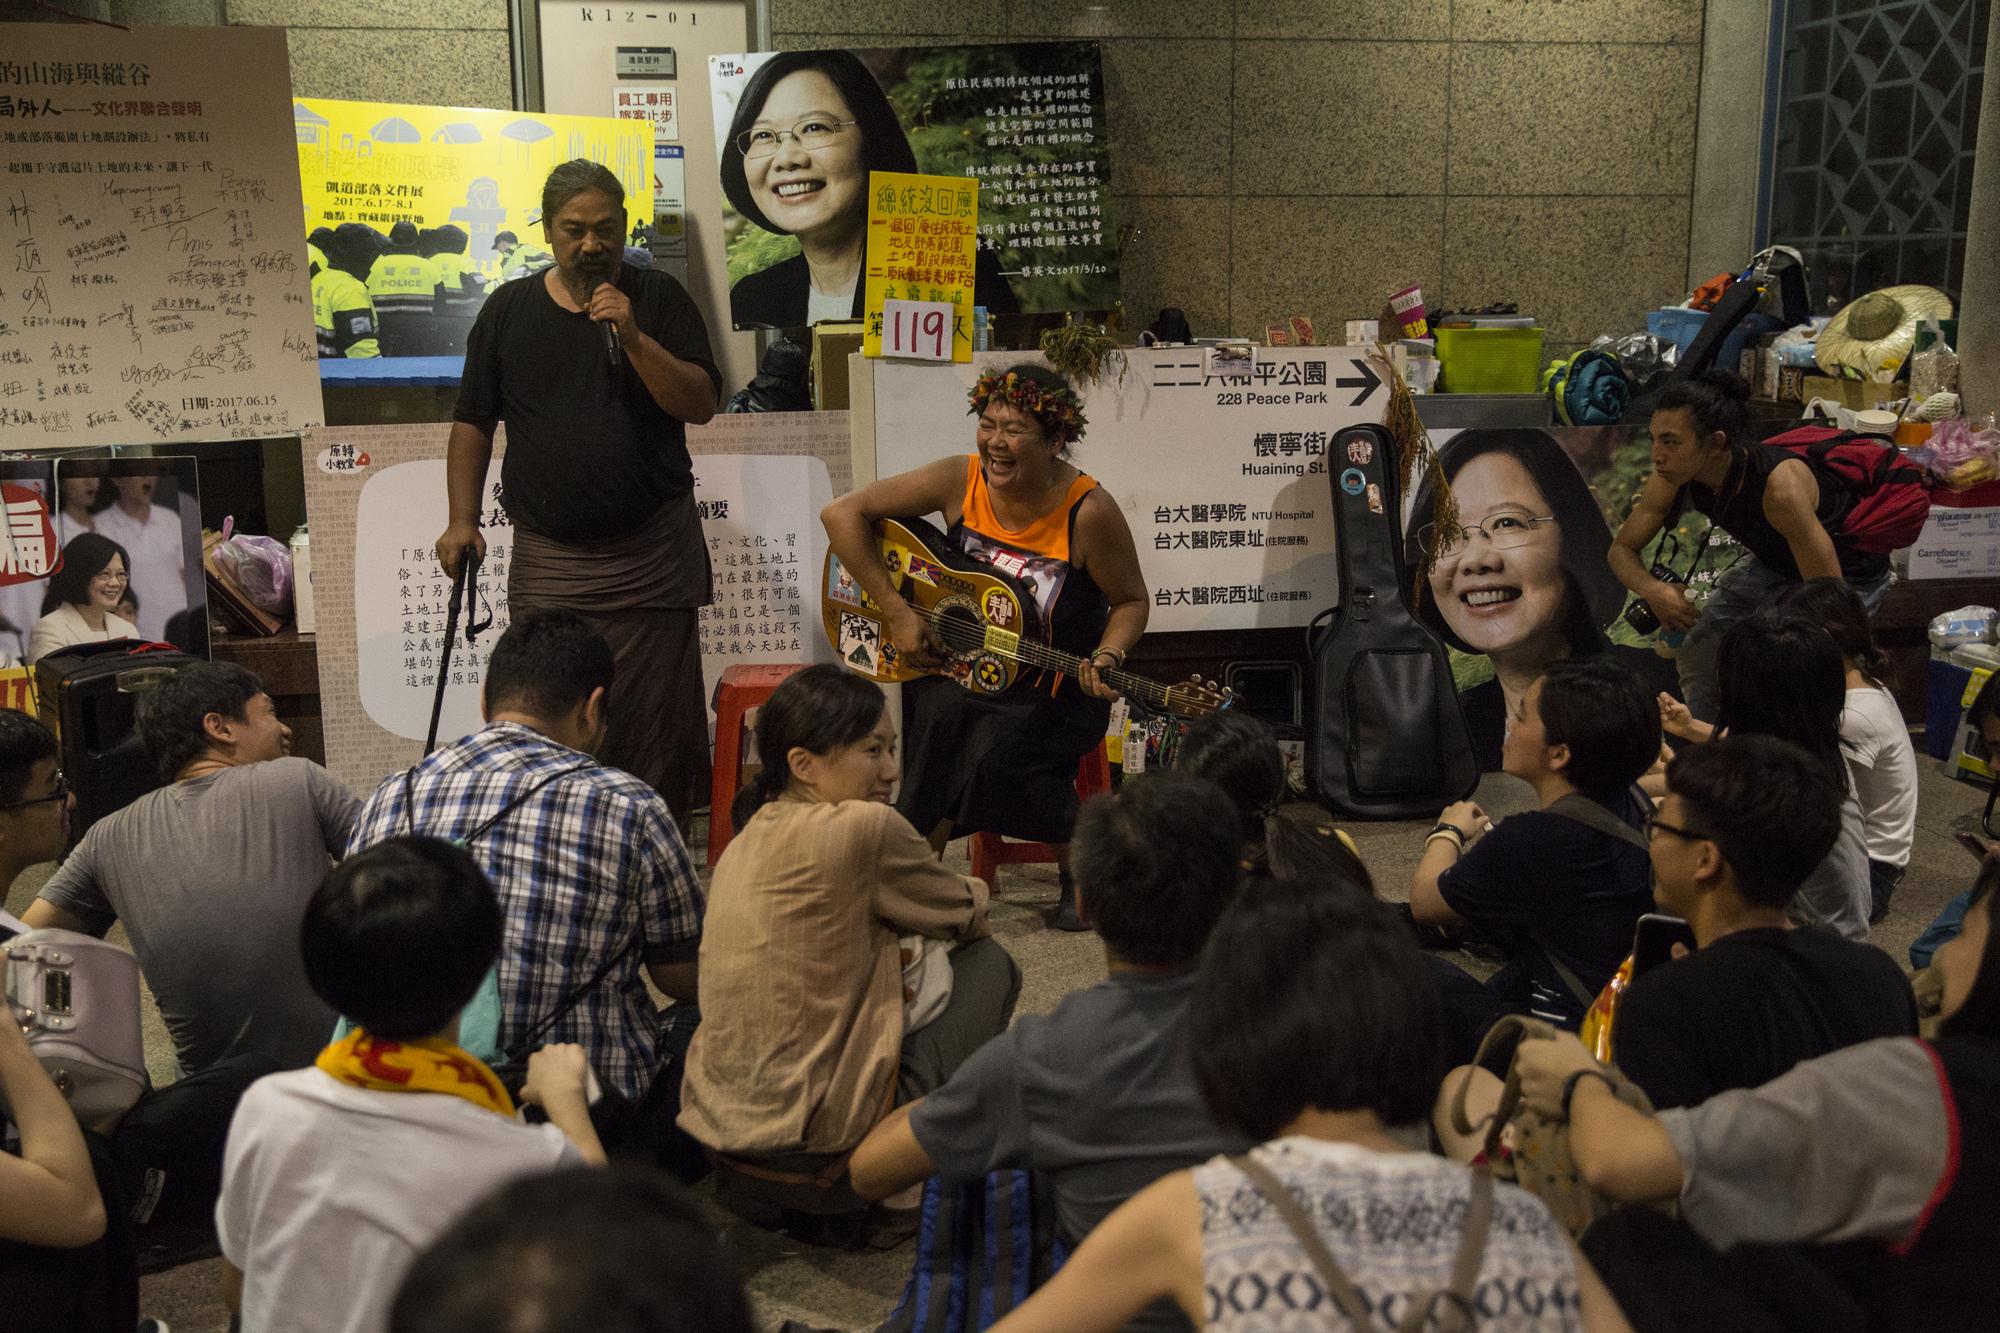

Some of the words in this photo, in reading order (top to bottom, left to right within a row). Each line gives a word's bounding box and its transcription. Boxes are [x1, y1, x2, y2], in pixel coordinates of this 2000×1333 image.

[0, 61, 150, 86] 的山海與縱谷
[946, 74, 1089, 89] 原住民族對傳統領域的理解
[619, 93, 672, 107] 員工專用
[1020, 89, 1091, 102] 是事實的陳述
[619, 110, 672, 123] 旅客止步
[985, 103, 1092, 117] 也是自然主權的概念
[655, 126, 667, 134] nly
[985, 117, 1093, 132] 這是完整的空間範圍
[987, 132, 1095, 146] 而不是所有權的概念
[966, 160, 1097, 177] 傳統領域是先存在的事實
[326, 181, 424, 197] 凱道部落文件展
[333, 196, 413, 209] 2017.6.17-8.1
[877, 183, 973, 217] 總統沒回應
[993, 190, 1099, 206] 則是後面才發生的事
[1030, 205, 1101, 217] 兩者有所區別
[381, 279, 423, 288] POLICE
[894, 311, 945, 356] 119
[1217, 393, 1242, 405] 228
[1247, 393, 1290, 405] Peace
[1295, 392, 1327, 404] Park
[329, 444, 354, 457] 原轉
[1253, 432, 1327, 457] 懷寧街
[326, 458, 355, 470] 小教室
[1242, 463, 1304, 477] Huaining
[1309, 462, 1327, 474] St.
[1154, 504, 1247, 524] 台大醫學院
[1252, 512, 1272, 520] NTU
[1275, 510, 1314, 521] Hospital
[1918, 549, 1959, 557] Carrefour
[406, 671, 479, 688] 這裡原因
